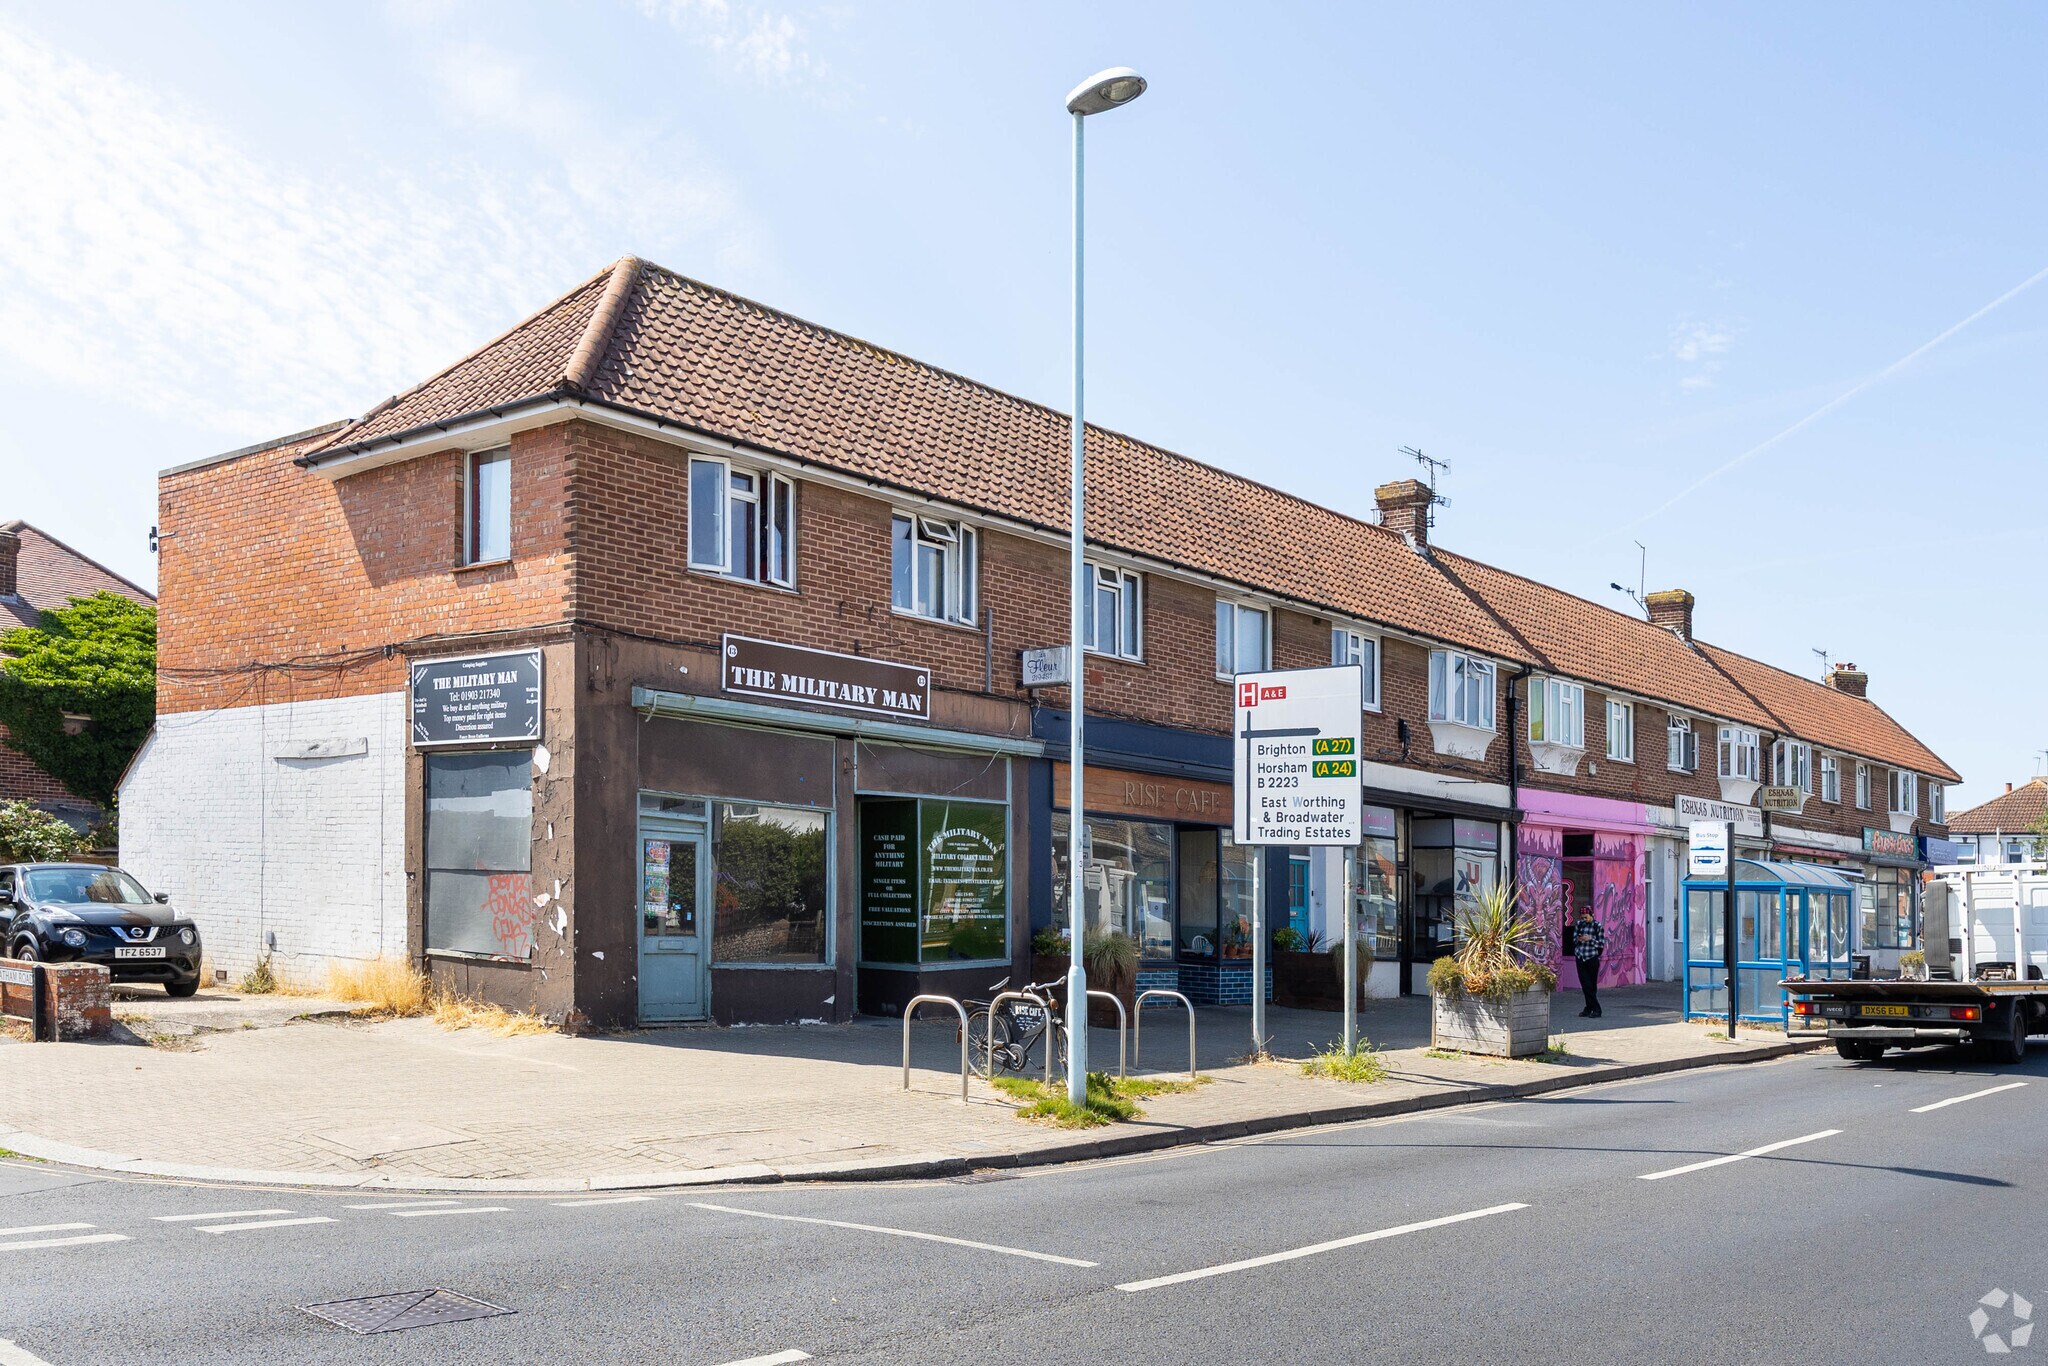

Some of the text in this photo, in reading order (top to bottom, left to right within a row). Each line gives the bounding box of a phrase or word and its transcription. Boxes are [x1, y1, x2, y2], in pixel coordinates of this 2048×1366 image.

[728, 647, 736, 655] 13
[1027, 658, 1058, 674] Fleur
[433, 677, 452, 690] THE
[453, 672, 496, 688] MILITARY
[498, 670, 518, 684] MAN
[449, 688, 500, 702] Tel: 01903 217340
[731, 665, 922, 712] THE MILITARY MAN
[1241, 684, 1256, 707] H
[450, 704, 458, 713] buy
[472, 702, 490, 711] anything
[491, 701, 508, 710] military
[443, 715, 451, 723] Top
[467, 713, 476, 721] paid
[484, 712, 494, 721] right
[456, 722, 494, 731] Discretion assured
[1257, 739, 1352, 757] Brighton (A 27)
[1258, 762, 1352, 776] Horsham (A 24)
[1258, 777, 1299, 788] B 2223
[1123, 781, 1222, 814] RISE CAFE
[1261, 796, 1346, 809] East Worthing
[1263, 812, 1344, 823] & Broadwater
[1710, 804, 1744, 822] NUTRITION
[1258, 827, 1351, 839] Trading Estates
[927, 828, 998, 854] THE MILITARY MAN
